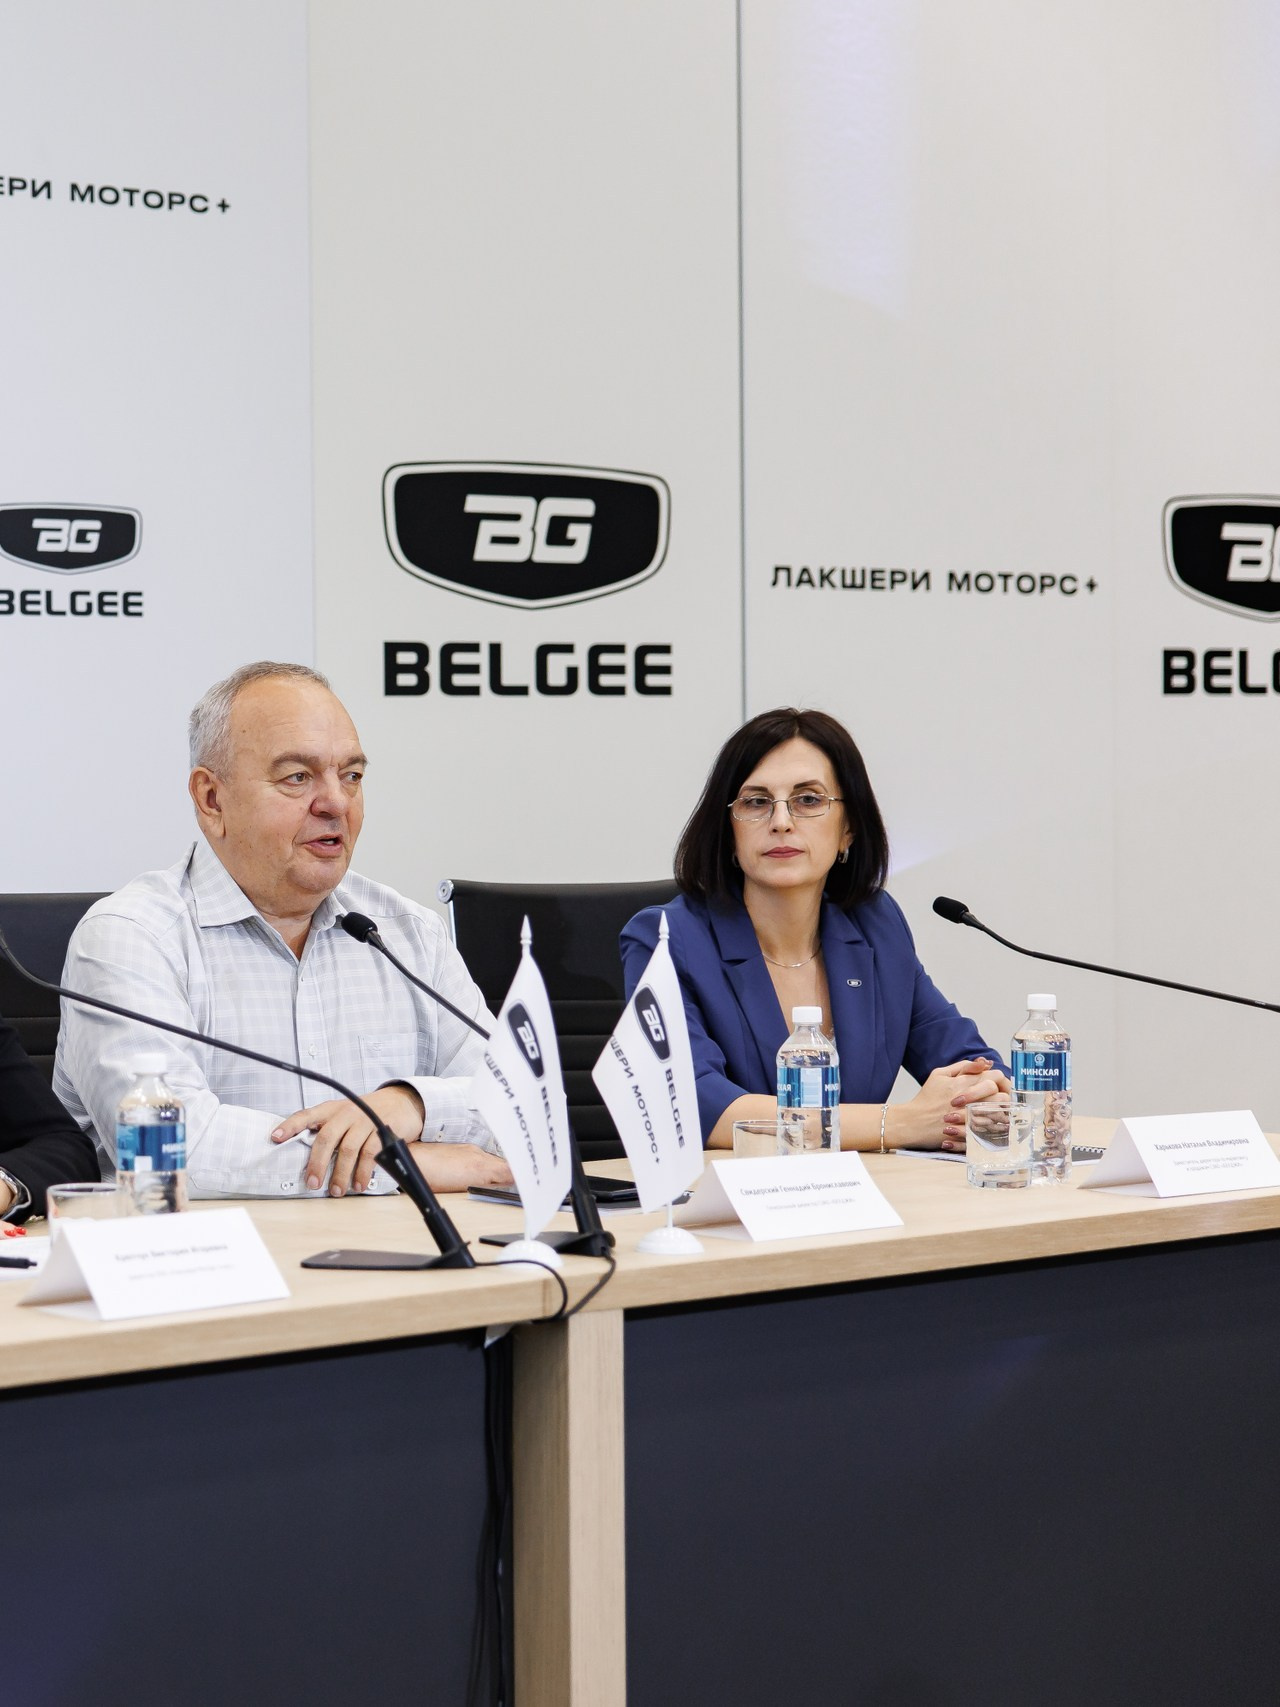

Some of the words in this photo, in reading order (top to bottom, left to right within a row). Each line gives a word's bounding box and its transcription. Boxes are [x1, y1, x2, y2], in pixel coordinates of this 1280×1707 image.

[70, 183, 231, 214] МОТОРС+
[31, 518, 102, 553] BG
[464, 494, 596, 564] BG
[1221, 522, 1280, 583] B
[771, 566, 931, 591] ЛАКШЕРИ
[948, 571, 1097, 596] МОТОРС+
[383, 641, 672, 697] BELGEE
[1162, 649, 1280, 695] BEL
[1020, 1068, 1059, 1076] МИНСКАЯ
[541, 1085, 558, 1168] BELGEE
[664, 1067, 686, 1148] BELGEE
